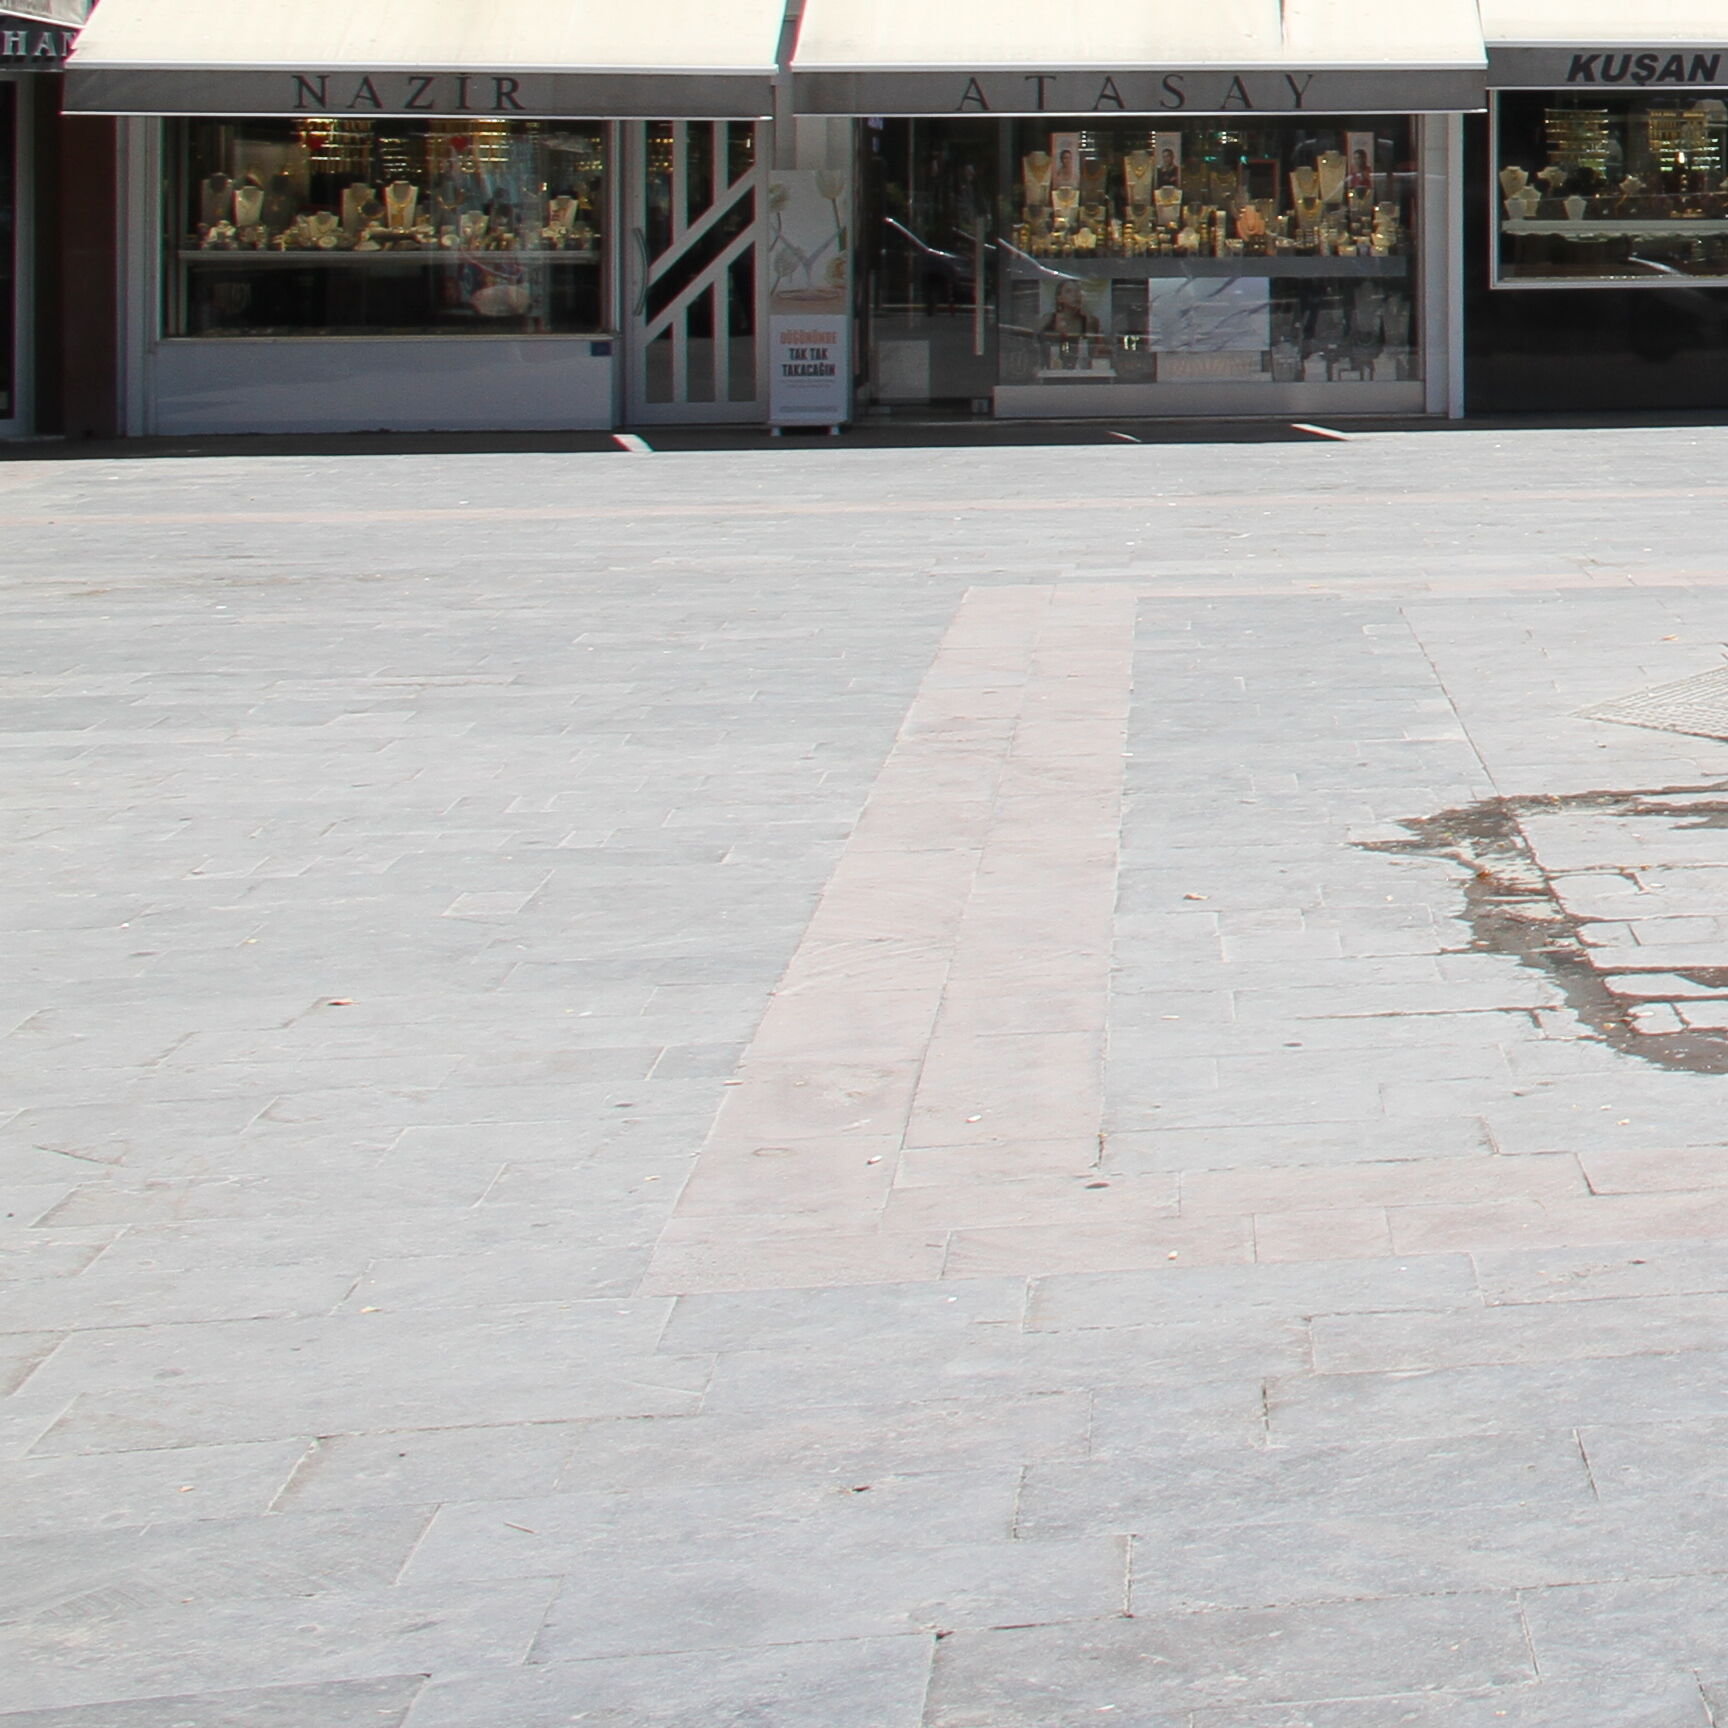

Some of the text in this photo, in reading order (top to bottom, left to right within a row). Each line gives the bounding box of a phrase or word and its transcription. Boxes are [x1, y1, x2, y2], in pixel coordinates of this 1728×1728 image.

[1566, 53, 1720, 87] KUŞAN
[291, 72, 527, 111] NAZİR
[955, 73, 1314, 111] ATASAY
[789, 347, 829, 361] TAK TAK
